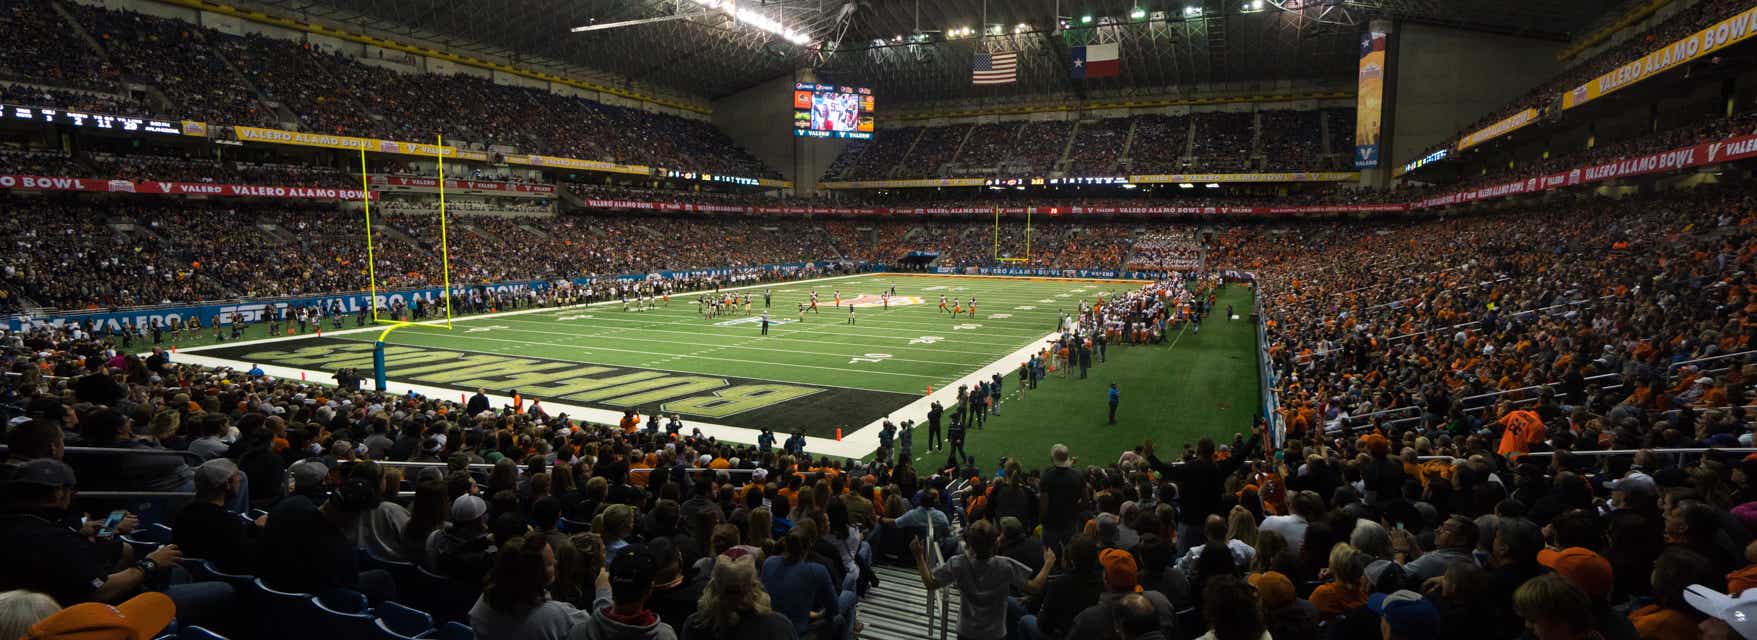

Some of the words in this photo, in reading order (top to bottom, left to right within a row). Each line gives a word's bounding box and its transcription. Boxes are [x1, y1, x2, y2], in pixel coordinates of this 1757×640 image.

[1599, 61, 1641, 93] VALERO
[1645, 37, 1699, 74] ALAMO
[1704, 11, 1757, 50] BOWL
[242, 129, 292, 141] VALERO
[296, 135, 338, 145] ALAMO
[422, 147, 450, 155] VALRO
[1585, 164, 1617, 181] VALERO
[1618, 156, 1657, 175] ALAMO
[1659, 148, 1695, 168] BOWL
[23, 178, 85, 189] BOWL
[181, 184, 222, 193] VALERO
[232, 186, 285, 196] VALERO
[289, 189, 336, 198] ALAMO
[340, 190, 373, 200] BOWL
[615, 200, 636, 208] ALAMO
[220, 302, 289, 324] ESPN
